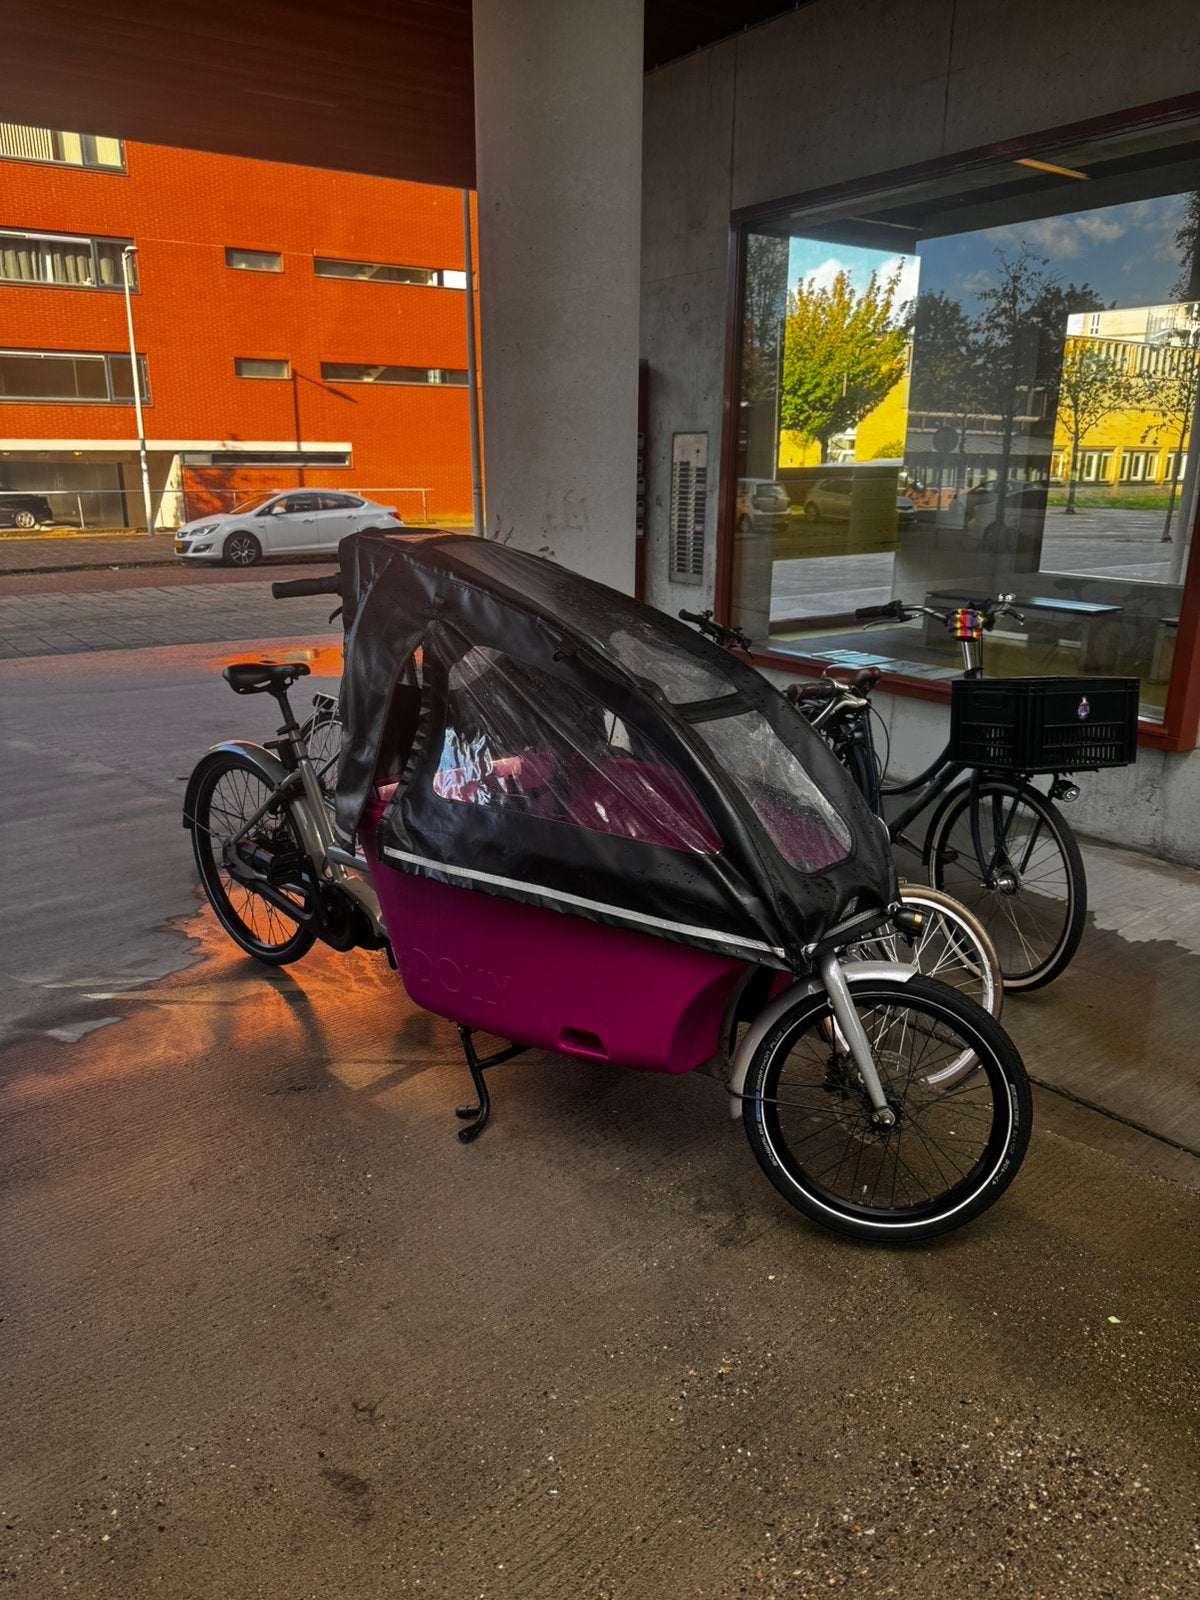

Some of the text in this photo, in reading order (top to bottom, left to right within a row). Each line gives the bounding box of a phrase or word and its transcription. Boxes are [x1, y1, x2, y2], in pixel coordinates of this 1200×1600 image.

[756, 1030, 784, 1167] SCHWALBE MARATHON PLUS
